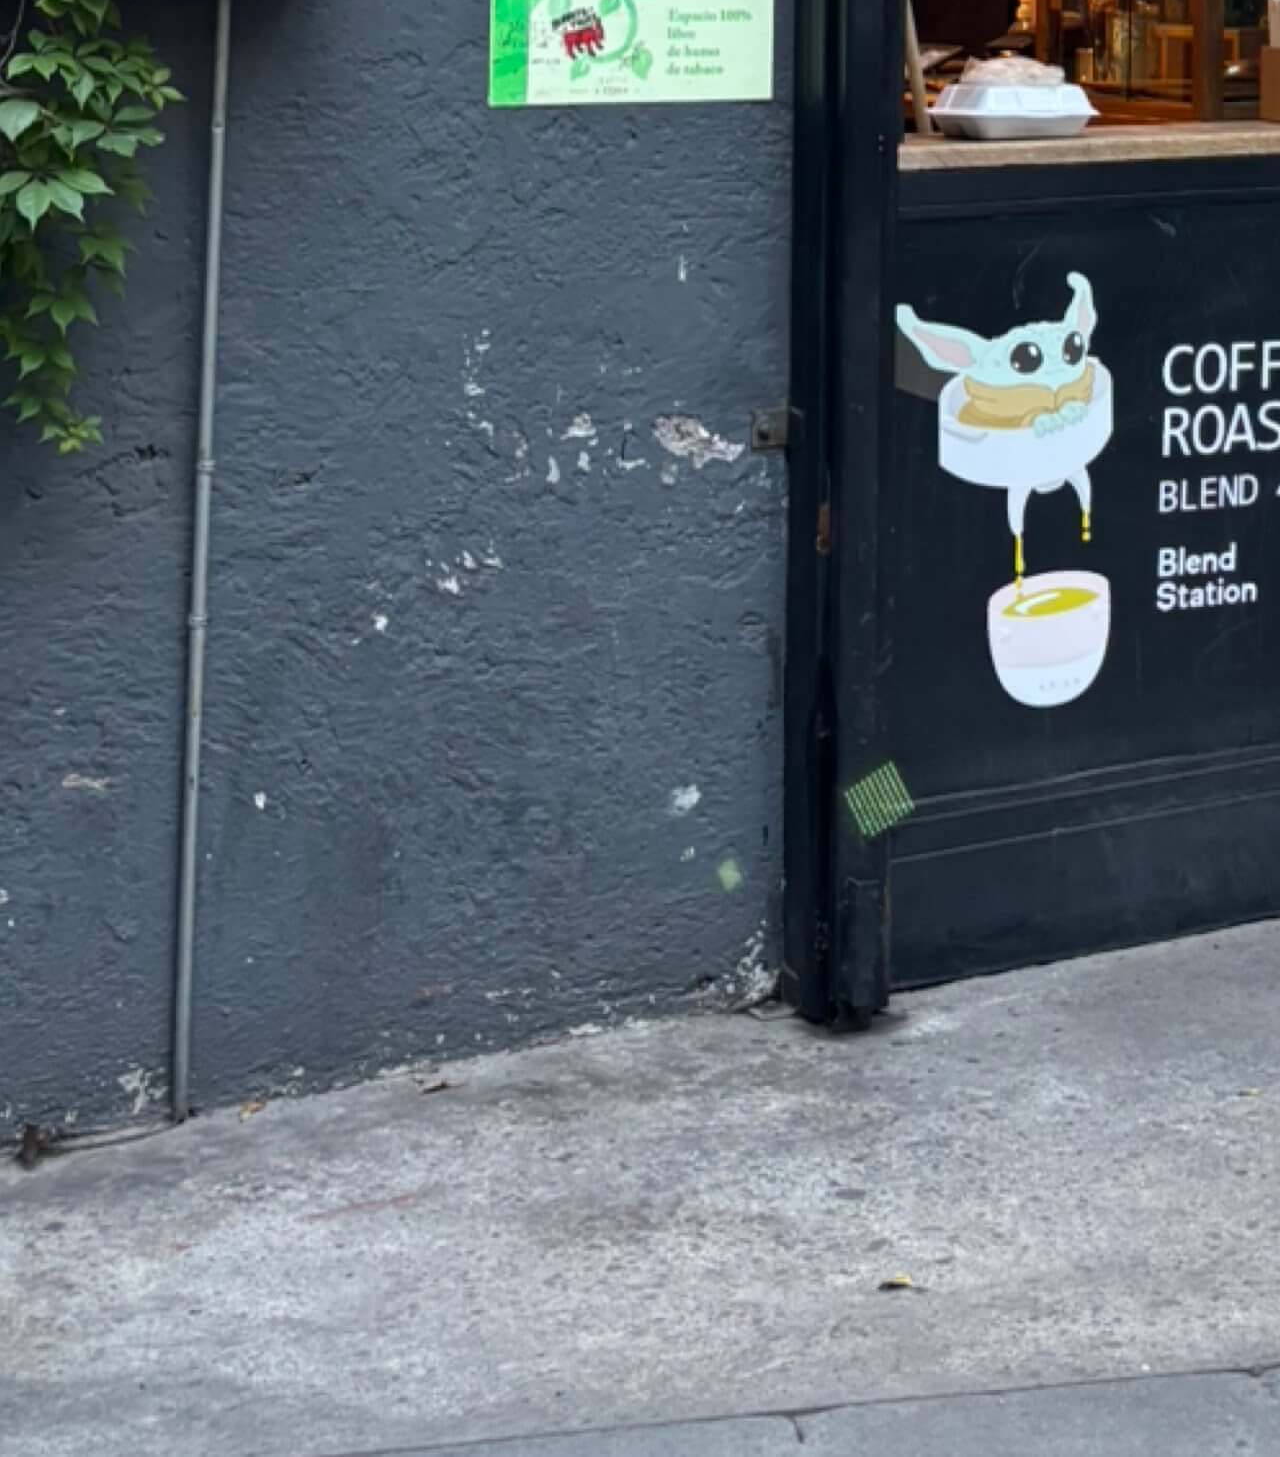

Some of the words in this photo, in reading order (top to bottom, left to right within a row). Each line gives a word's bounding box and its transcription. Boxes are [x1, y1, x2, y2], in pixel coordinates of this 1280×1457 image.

[669, 8, 717, 24] Espacio
[720, 9, 752, 21] 100%
[667, 27, 695, 39] libre
[667, 45, 680, 56] de
[666, 62, 680, 75] de
[684, 62, 723, 75] tabaco
[1158, 473, 1259, 513] BLEND
[1157, 541, 1238, 578] Blend
[1156, 577, 1258, 612] Station
